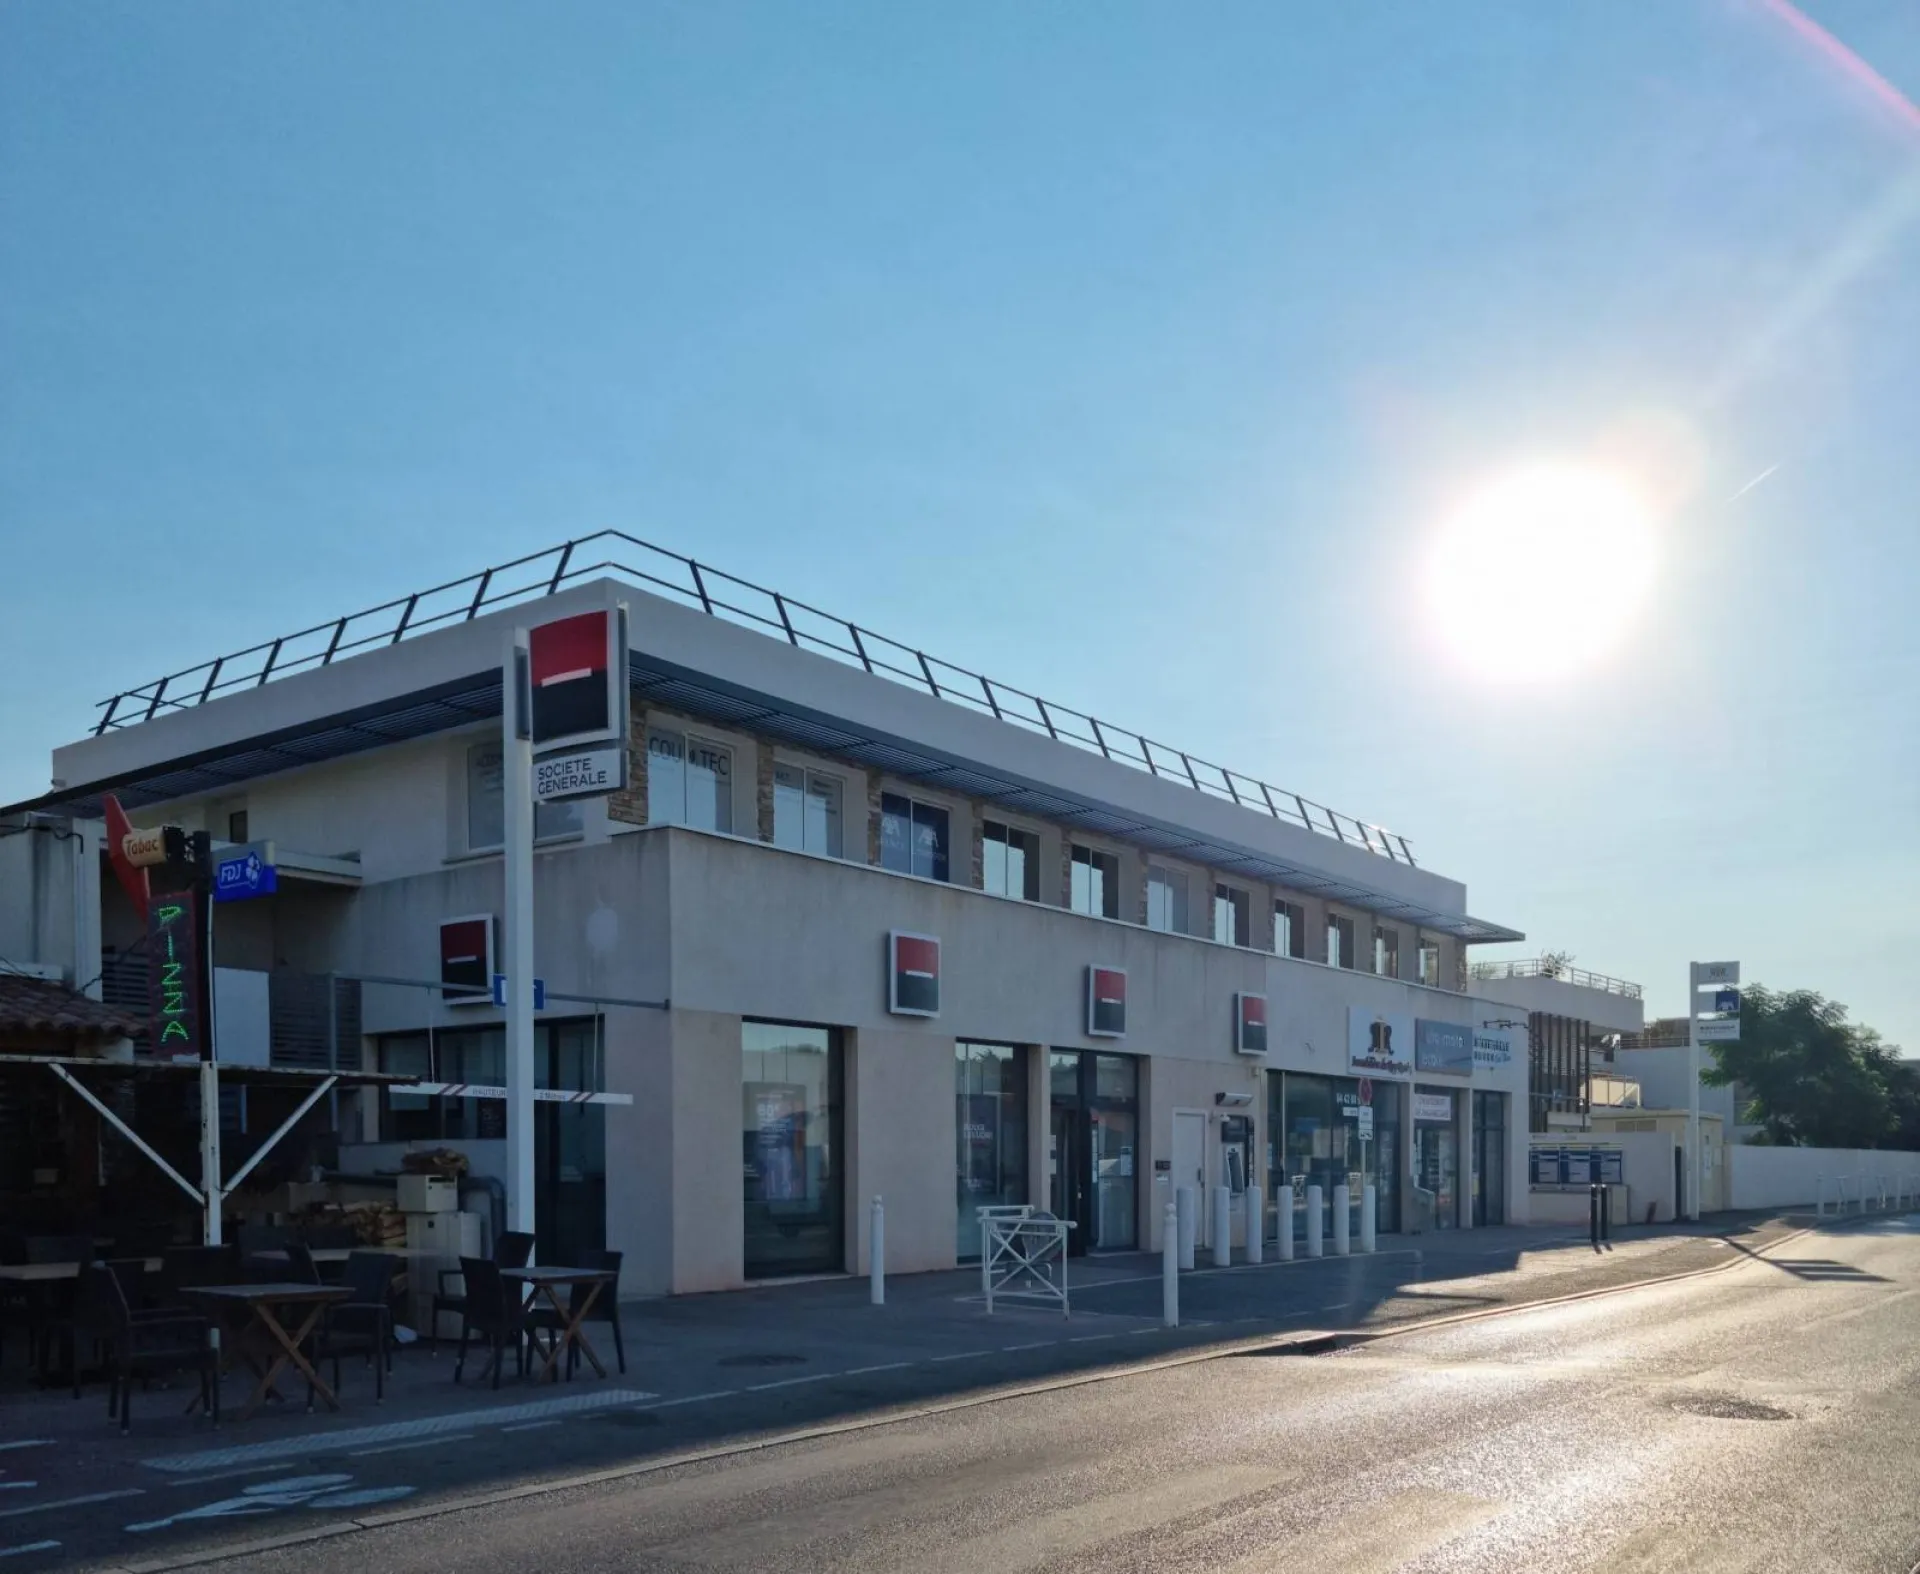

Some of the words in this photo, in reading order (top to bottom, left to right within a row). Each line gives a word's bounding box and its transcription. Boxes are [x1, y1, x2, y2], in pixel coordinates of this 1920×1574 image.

[537, 757, 592, 781] SOCIETE
[538, 770, 607, 795] GENERALE
[125, 837, 160, 857] Tabac
[221, 861, 242, 882] FDJ
[158, 905, 190, 1043] PIZZA
